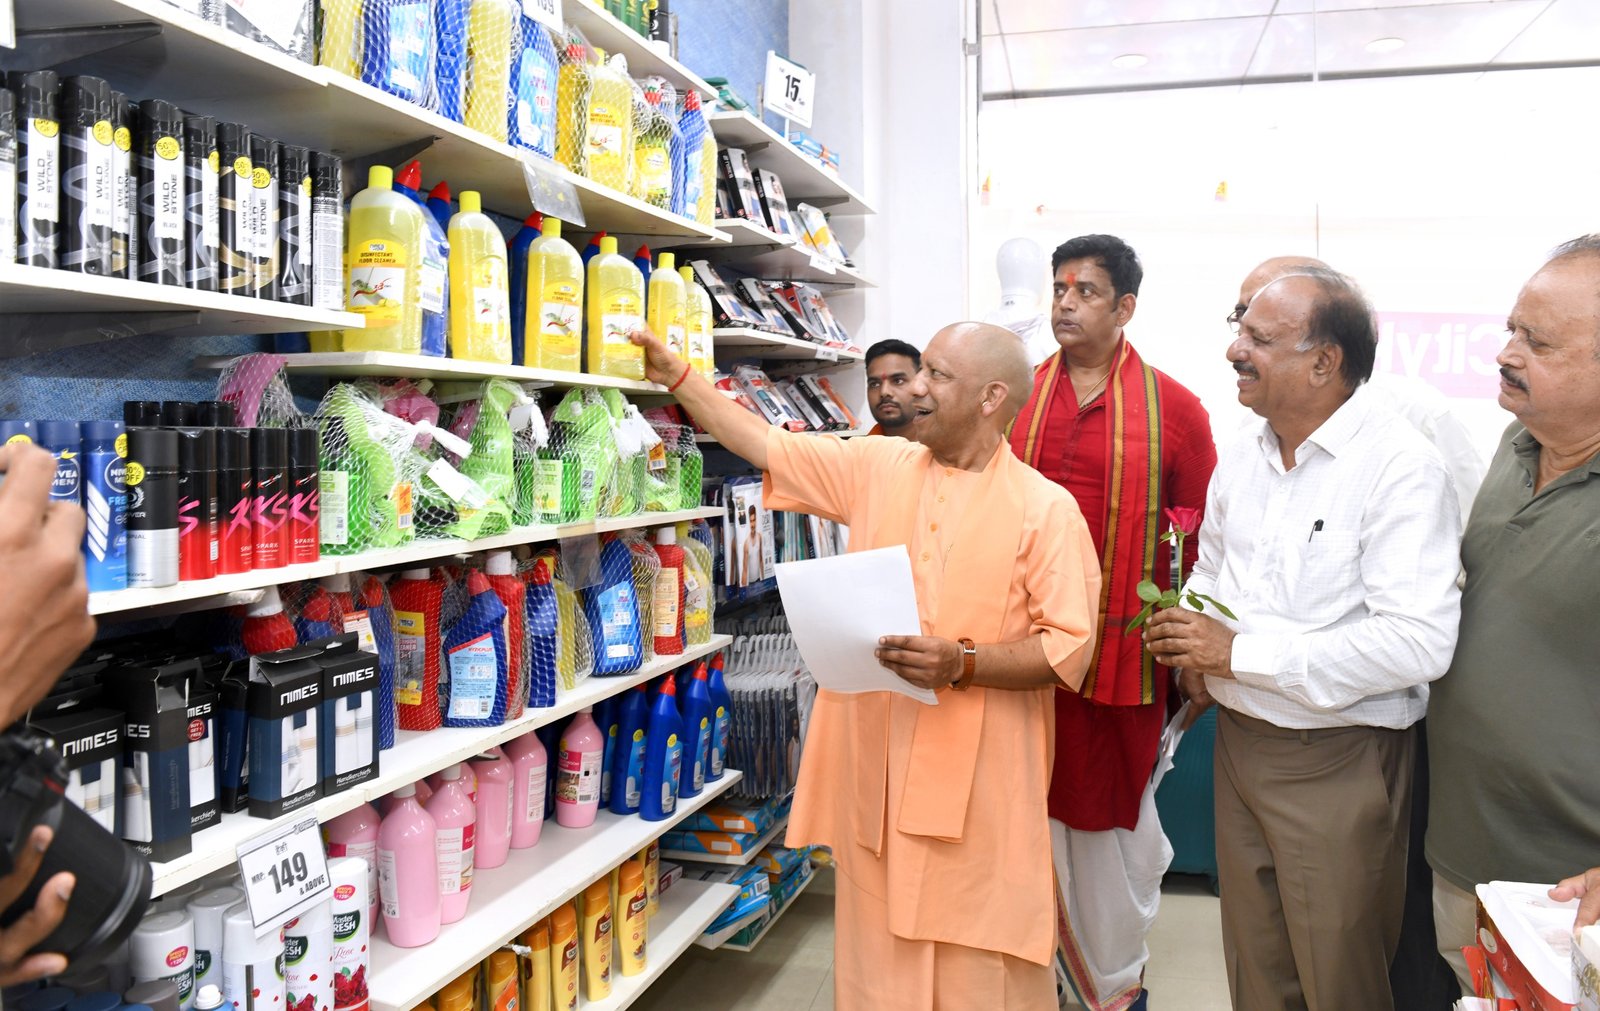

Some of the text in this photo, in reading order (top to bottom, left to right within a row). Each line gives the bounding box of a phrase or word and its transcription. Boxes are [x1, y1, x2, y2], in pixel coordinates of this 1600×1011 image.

[785, 74, 801, 102] 15
[37, 158, 46, 192] WILD
[96, 165, 104, 199] WILD
[259, 198, 267, 236] STONE
[53, 469, 78, 479] IVEA
[108, 496, 128, 506] FRE
[333, 666, 374, 688] NIMES
[280, 682, 319, 707] NIMES
[187, 702, 212, 719] MES
[124, 723, 150, 738] ES
[63, 728, 118, 758] NIMES
[336, 767, 372, 785] Handkerchiefs
[282, 789, 317, 808] Handkerchiefs
[190, 808, 216, 824] kerchiefs
[267, 851, 309, 895] 149
[299, 887, 305, 895] &
[304, 874, 326, 890] ABOVE
[333, 920, 356, 933] RESH
[285, 938, 299, 946] ster
[286, 946, 302, 956] ESH
[178, 981, 192, 993] ESH
